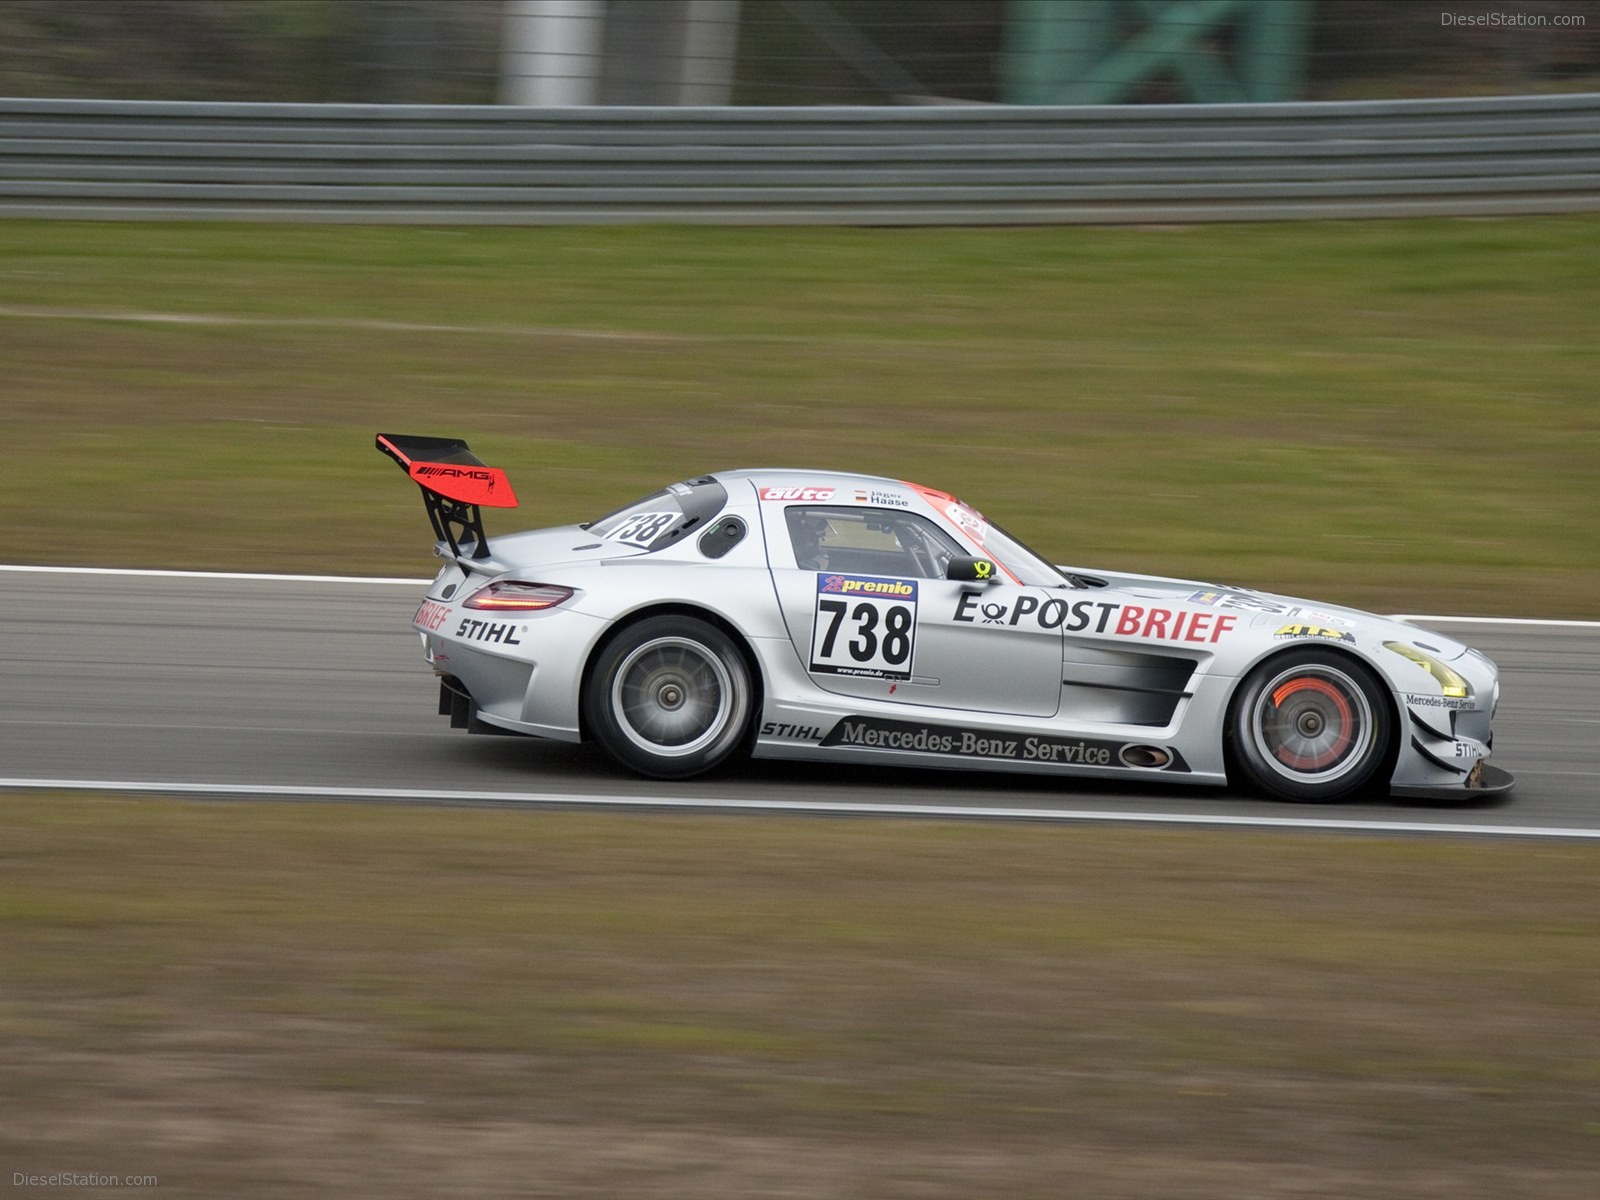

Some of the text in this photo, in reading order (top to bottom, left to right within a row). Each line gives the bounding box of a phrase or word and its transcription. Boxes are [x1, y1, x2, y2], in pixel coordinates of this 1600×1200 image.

[439, 468, 490, 480] AMG
[763, 487, 836, 500] auto
[871, 496, 909, 506] Haase
[606, 514, 674, 542] 738
[842, 579, 913, 595] premio
[415, 600, 453, 631] BRIEF
[456, 618, 521, 645] STIHL
[818, 599, 912, 665] 738
[837, 668, 883, 677] www.premio.de
[1406, 694, 1458, 708] Mercedes-Benz
[761, 722, 823, 740] STIHL
[841, 722, 1111, 764] Mercedes-Benz Service
[1456, 743, 1482, 757] STIHL
